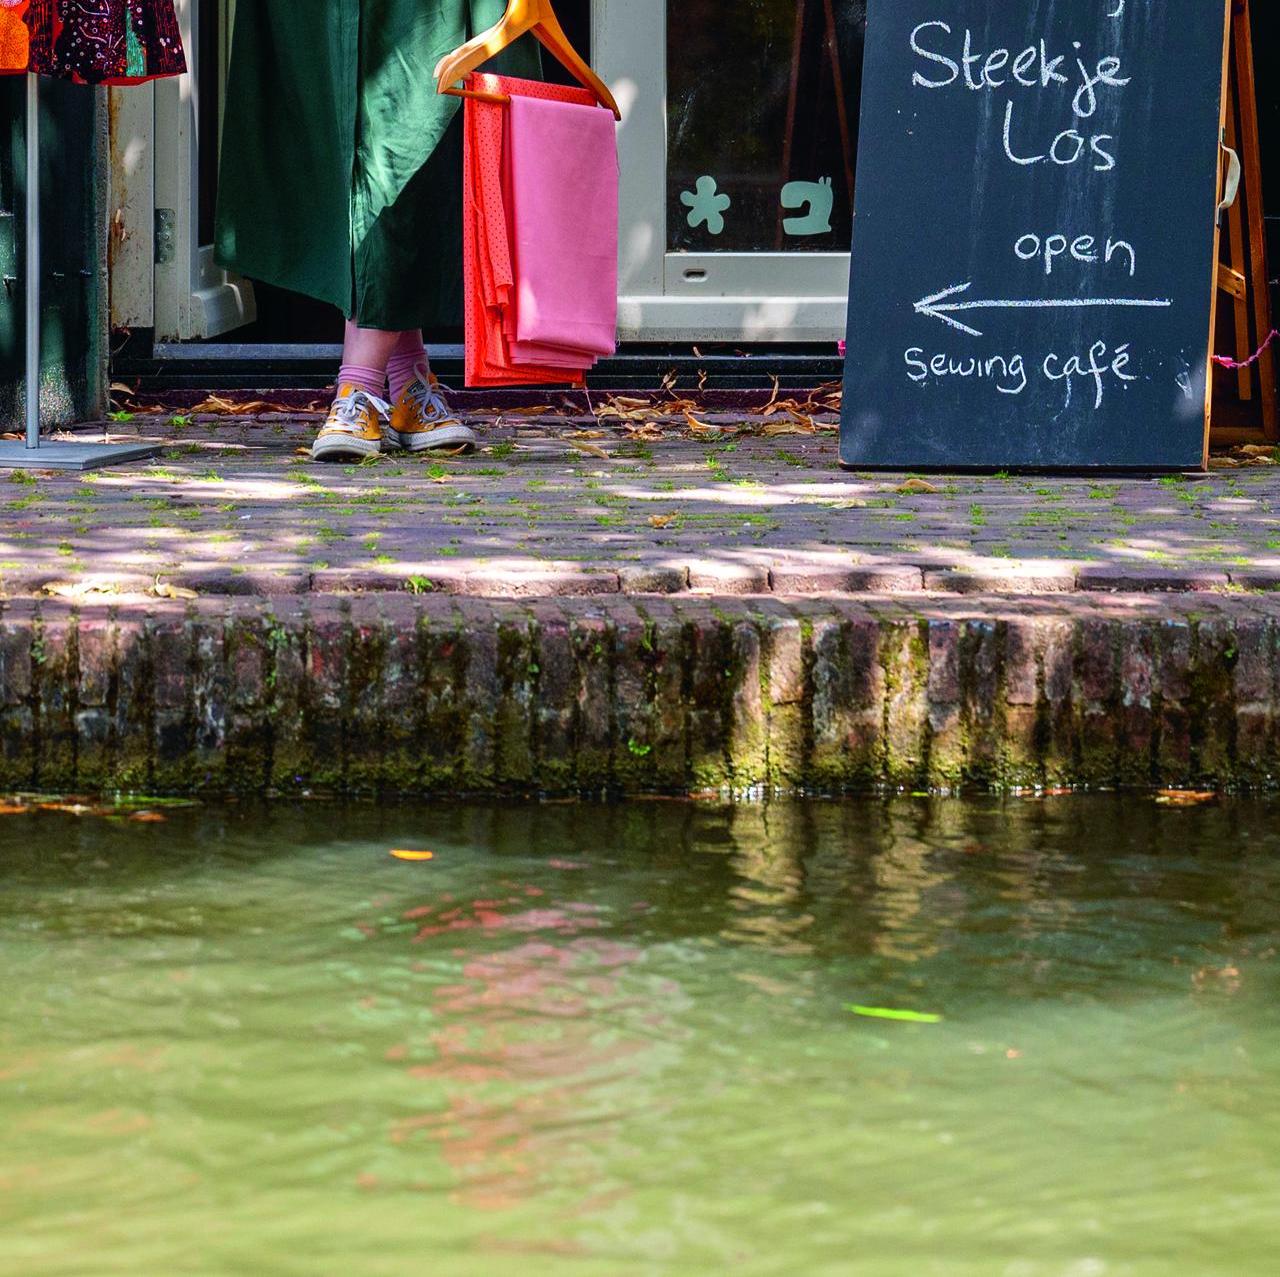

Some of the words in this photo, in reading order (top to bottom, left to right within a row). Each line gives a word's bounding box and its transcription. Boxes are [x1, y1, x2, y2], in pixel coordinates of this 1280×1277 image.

[909, 20, 1132, 118] Steekje
[1002, 99, 1116, 171] Los
[1013, 232, 1136, 276] open
[904, 346, 1027, 394] Sewing
[1043, 338, 1138, 410] café
